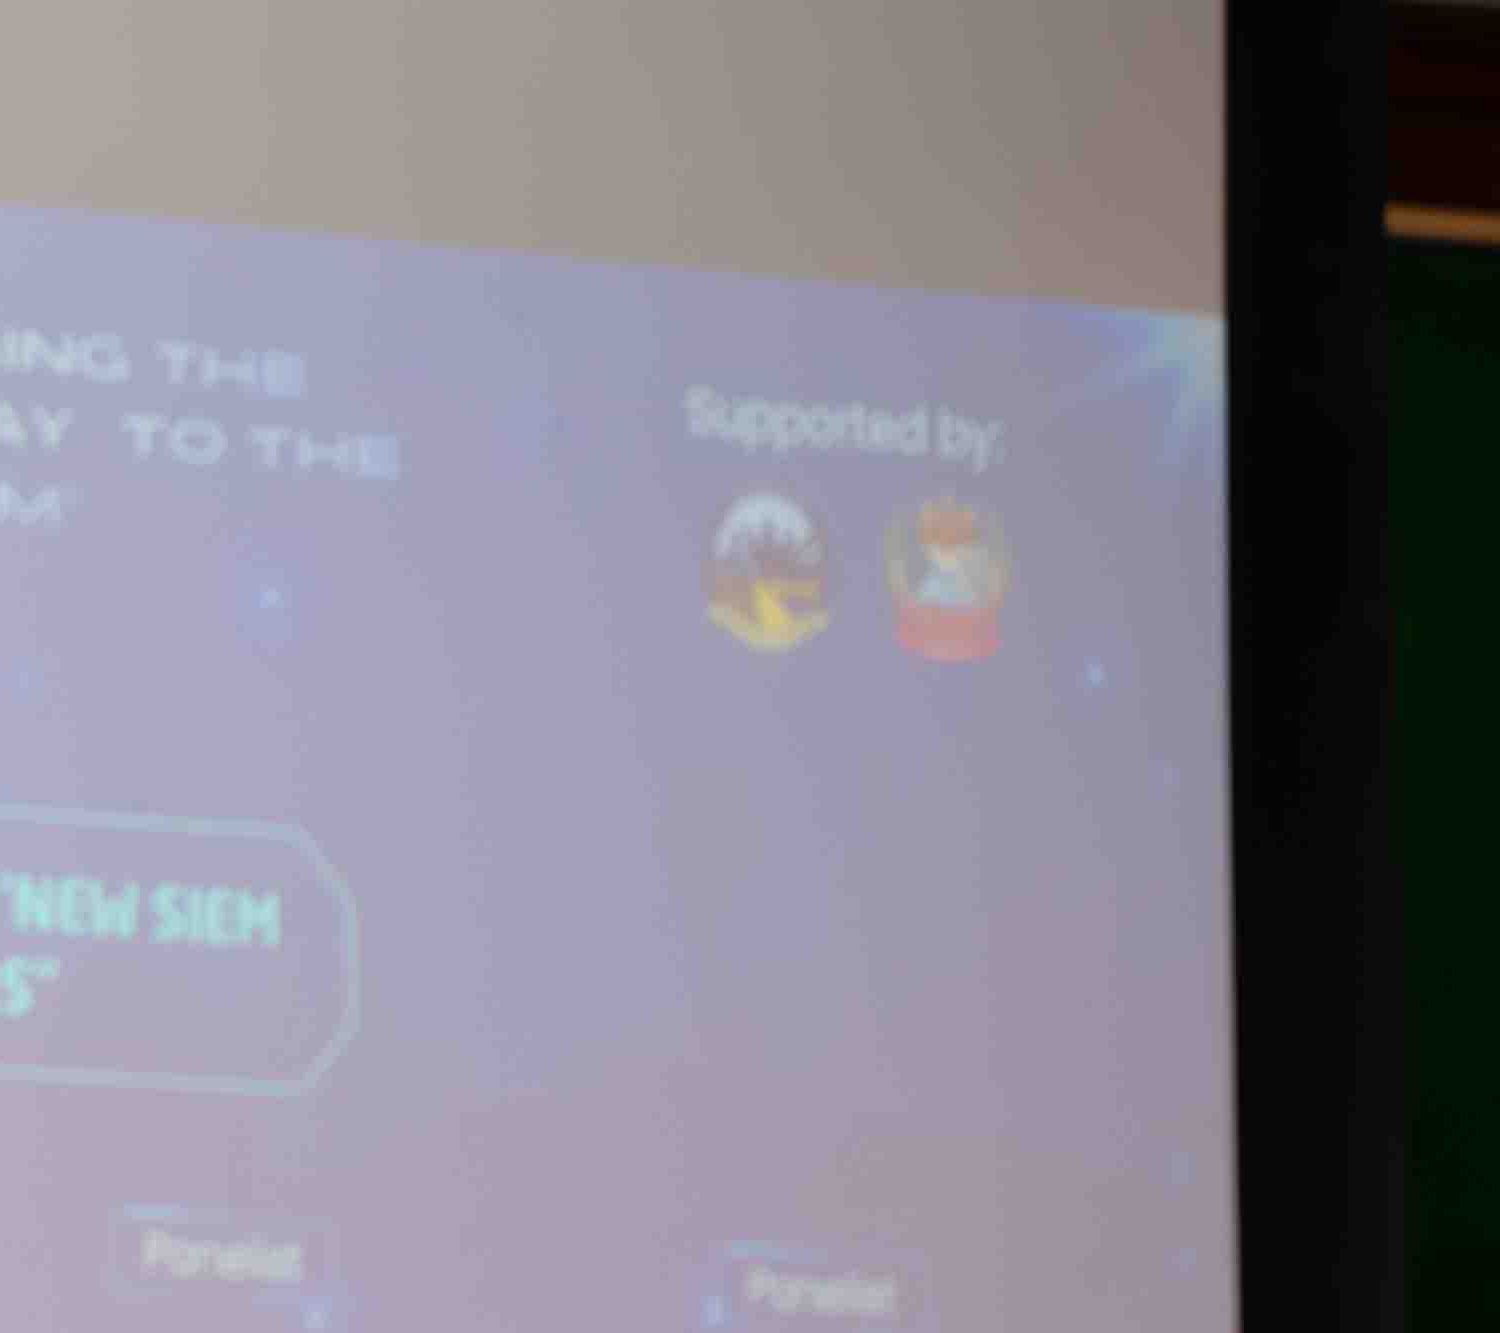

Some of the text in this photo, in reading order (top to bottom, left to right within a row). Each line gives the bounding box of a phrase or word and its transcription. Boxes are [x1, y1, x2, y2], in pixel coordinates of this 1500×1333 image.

[154, 338, 303, 398] THE
[121, 411, 227, 465] TO
[246, 425, 399, 480] THE
[683, 384, 928, 453] Supported
[148, 881, 283, 947] SIEM
[143, 1229, 304, 1281] Panelist
[746, 1264, 897, 1316] Panelist
